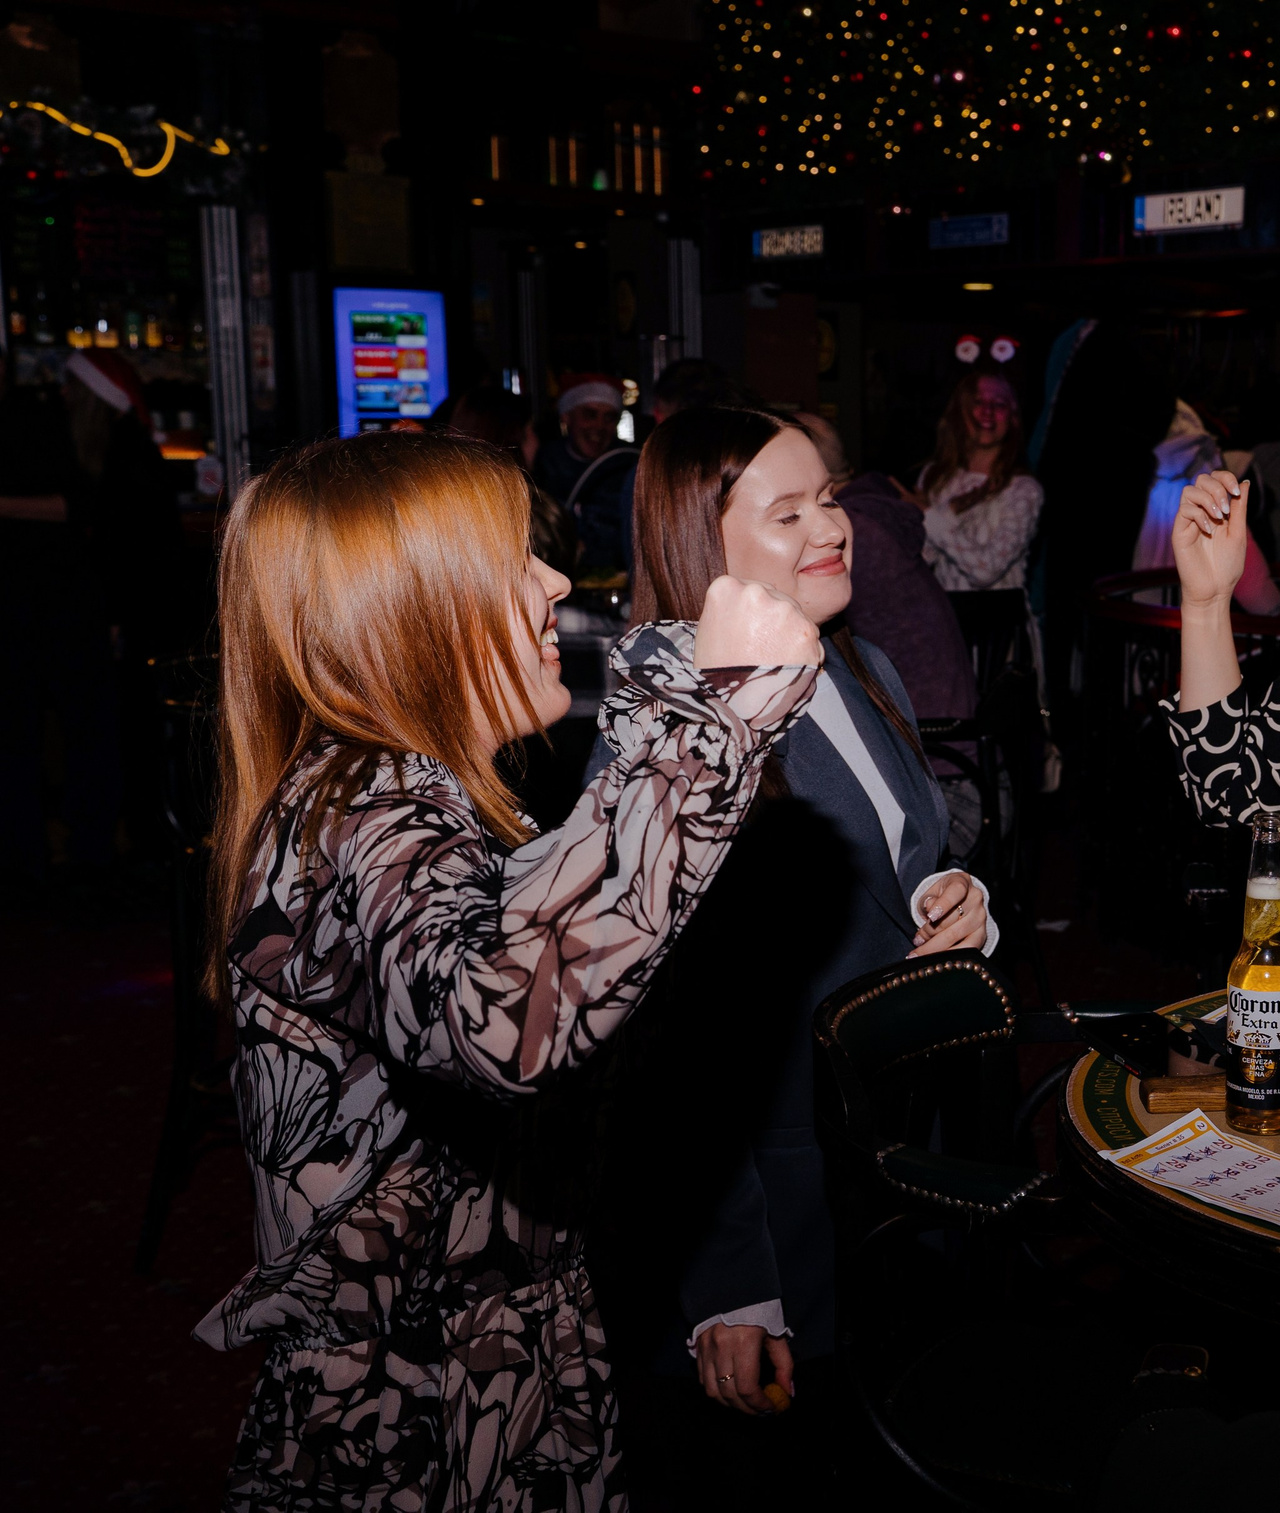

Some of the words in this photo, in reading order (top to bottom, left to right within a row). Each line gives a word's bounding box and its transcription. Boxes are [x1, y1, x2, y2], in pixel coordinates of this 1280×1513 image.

[1162, 193, 1223, 224] IRELAND
[1241, 1013, 1279, 1029] Extra
[1242, 1057, 1273, 1065] CERVEZA
[1212, 1138, 1234, 1150] 20
[1253, 1154, 1272, 1164] 12
